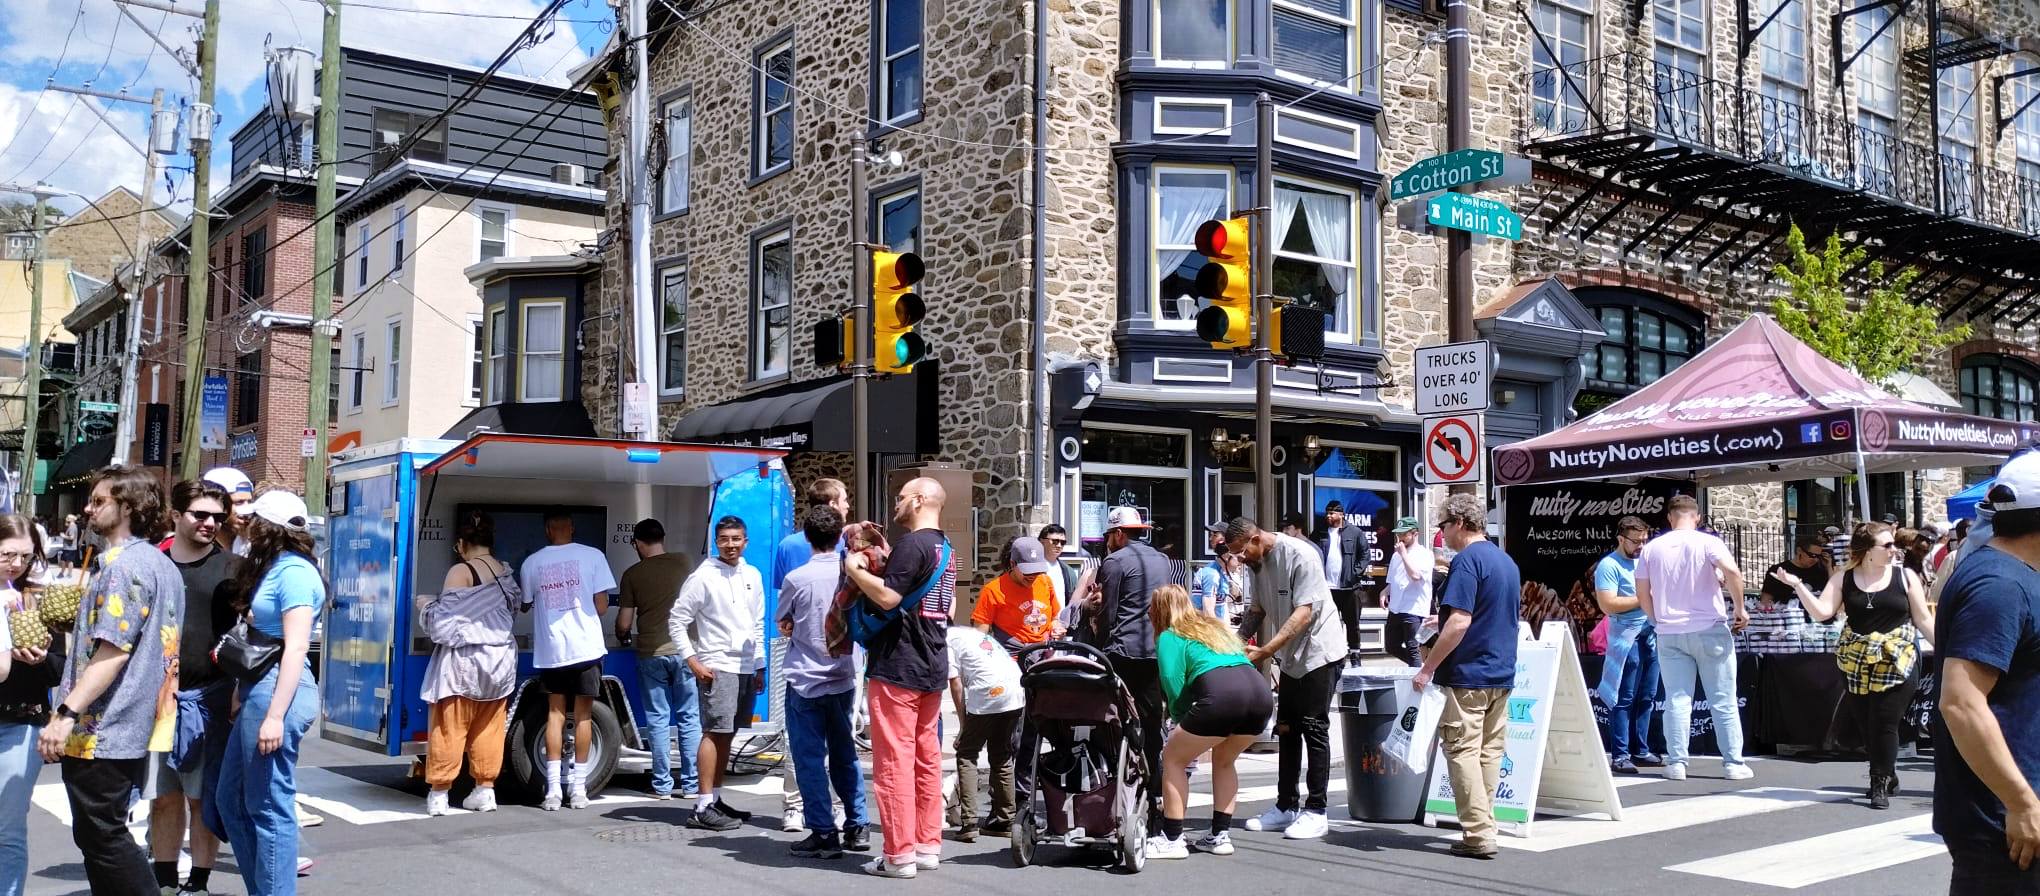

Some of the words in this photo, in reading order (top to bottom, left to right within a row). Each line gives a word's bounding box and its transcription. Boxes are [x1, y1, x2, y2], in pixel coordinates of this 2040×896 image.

[1428, 158, 1439, 168] 100
[1409, 165, 1471, 194] Cotton
[1480, 156, 1499, 177] St
[1473, 198, 1479, 208] N
[1451, 206, 1489, 232] Main
[1496, 216, 1513, 237] St
[1427, 351, 1476, 368] TRUCKS
[1423, 375, 1456, 388] OVER
[1460, 370, 1481, 385] 40'
[1435, 393, 1468, 407] LONG
[1529, 490, 1582, 524] nutty
[1578, 487, 1665, 516] novelties
[1526, 526, 1582, 541] Awesome
[1586, 525, 1613, 540] Nut
[541, 581, 565, 592] THANK
[565, 579, 580, 588] YOU
[349, 602, 374, 622] WATER
[1495, 782, 1515, 799] lie
